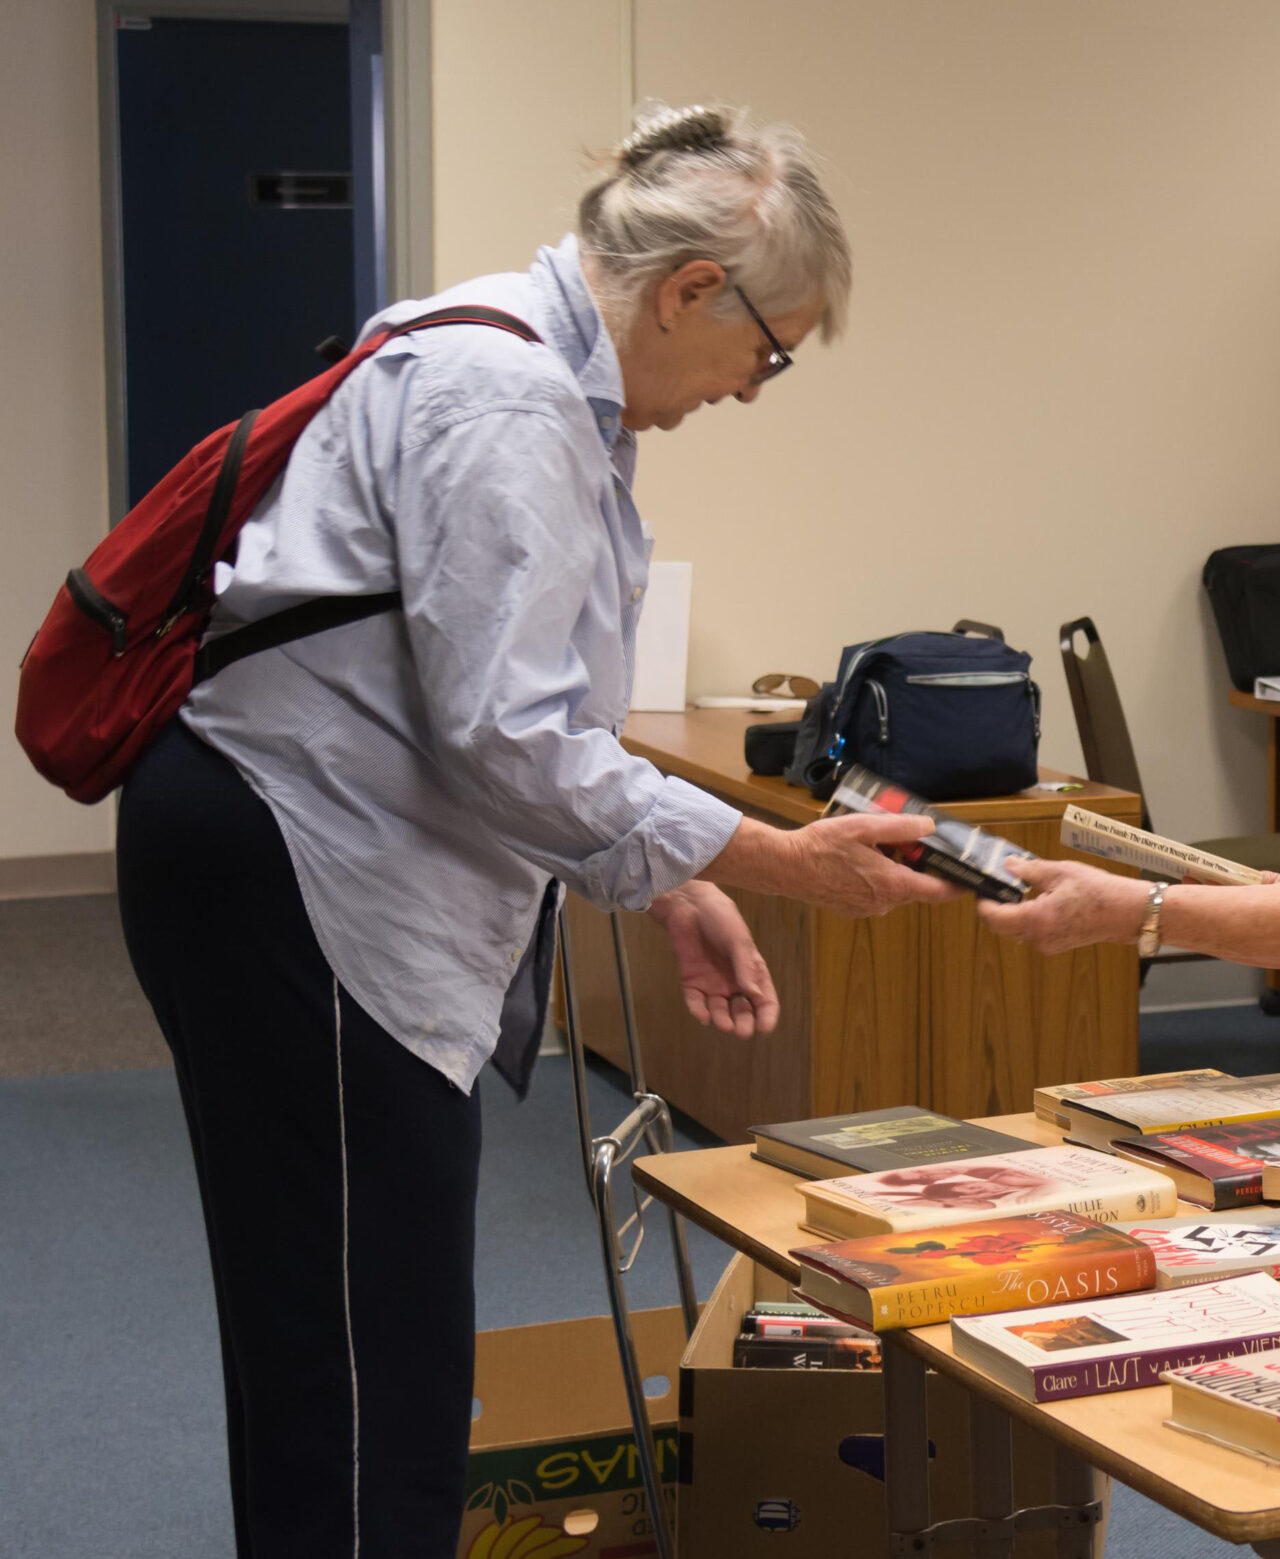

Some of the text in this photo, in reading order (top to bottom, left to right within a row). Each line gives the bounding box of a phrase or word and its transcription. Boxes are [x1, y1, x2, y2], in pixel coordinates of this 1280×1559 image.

[1093, 820, 1109, 832] Anne
[1129, 832, 1141, 843] The
[1141, 836, 1157, 850] Diary
[1169, 847, 1188, 861] Young
[1187, 853, 1200, 865] Girl
[1068, 1199, 1104, 1214] JULIE
[896, 1285, 958, 1305] PETRU
[993, 1267, 1119, 1303] The OASIS
[897, 1295, 985, 1321] POPESCU
[1042, 1374, 1078, 1393] Clare
[1095, 1357, 1141, 1389] LAST
[1149, 1354, 1208, 1375] WALTZ
[1218, 1349, 1236, 1361] IN
[536, 1438, 679, 1490] NAS
